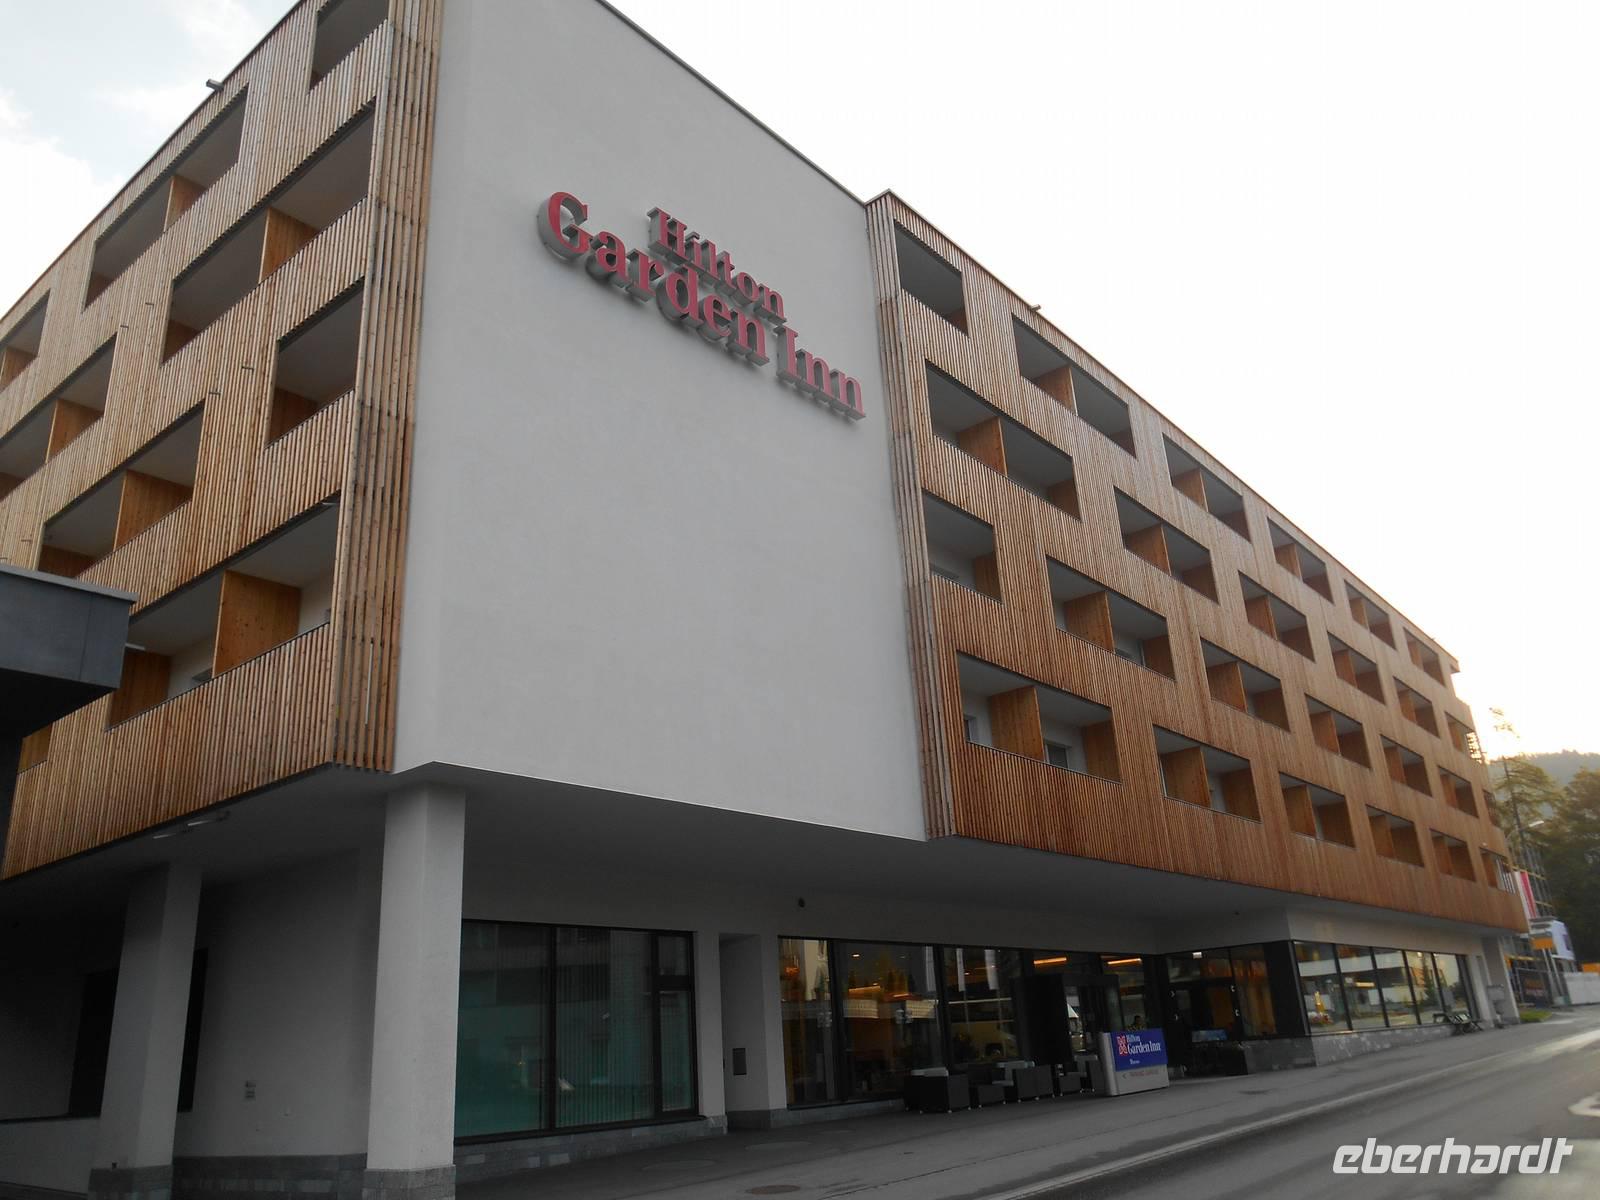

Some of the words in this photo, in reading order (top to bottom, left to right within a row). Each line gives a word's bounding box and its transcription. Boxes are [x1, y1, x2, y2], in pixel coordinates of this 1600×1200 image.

[537, 191, 769, 366] Garden
[774, 325, 866, 420] Inn
[647, 207, 786, 323] Hilton
[1128, 1041, 1149, 1054] Garden
[1149, 1040, 1161, 1052] Inn
